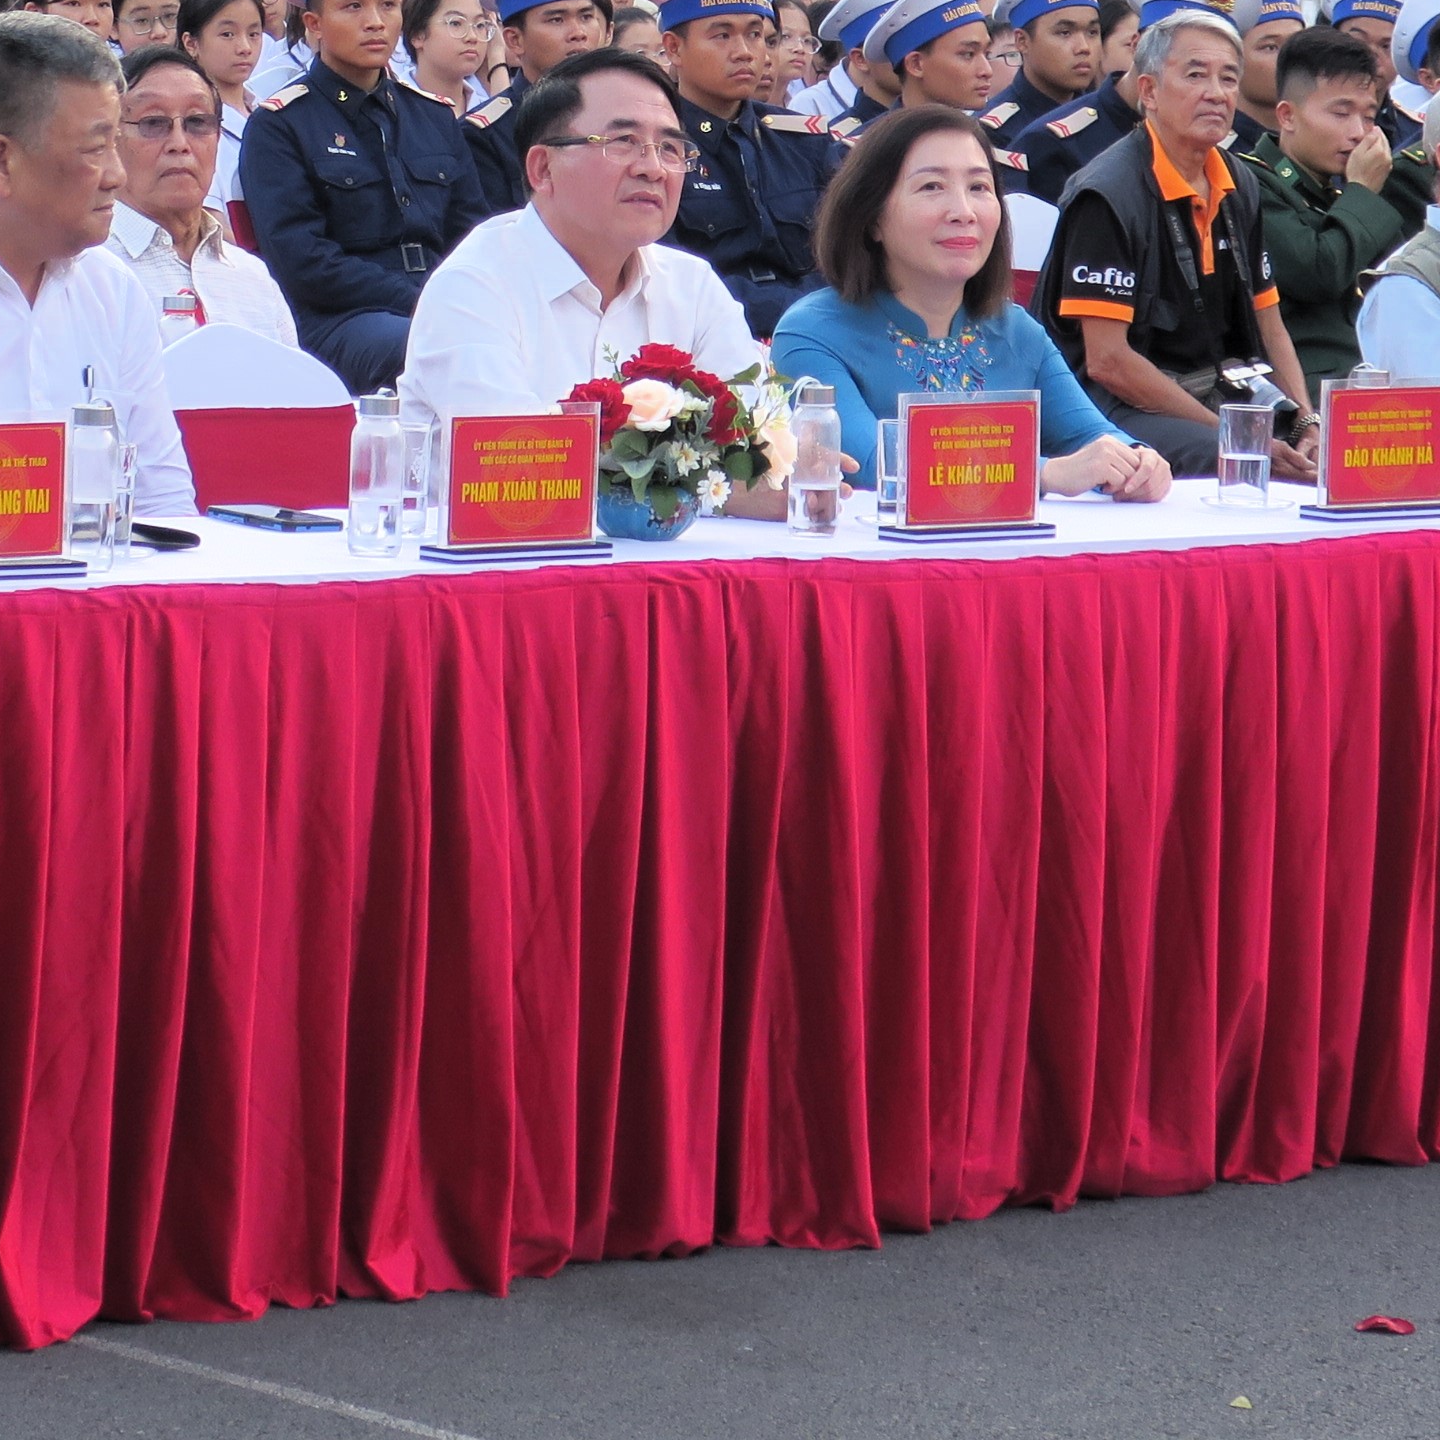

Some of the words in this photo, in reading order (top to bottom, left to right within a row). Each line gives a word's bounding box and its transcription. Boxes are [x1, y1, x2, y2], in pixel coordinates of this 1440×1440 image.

[1072, 265, 1136, 288] Cafio
[1344, 445, 1369, 468] ĐÀO
[1372, 444, 1413, 466] KHÁNH
[1417, 442, 1433, 465] HÀ
[929, 462, 944, 486] LÊ
[948, 457, 981, 485] KHẮC
[986, 463, 1015, 484] NAM
[25, 488, 50, 514] MAI
[461, 482, 499, 507] PHẠM
[502, 476, 537, 501] XUÂN
[540, 479, 581, 500] THANH
